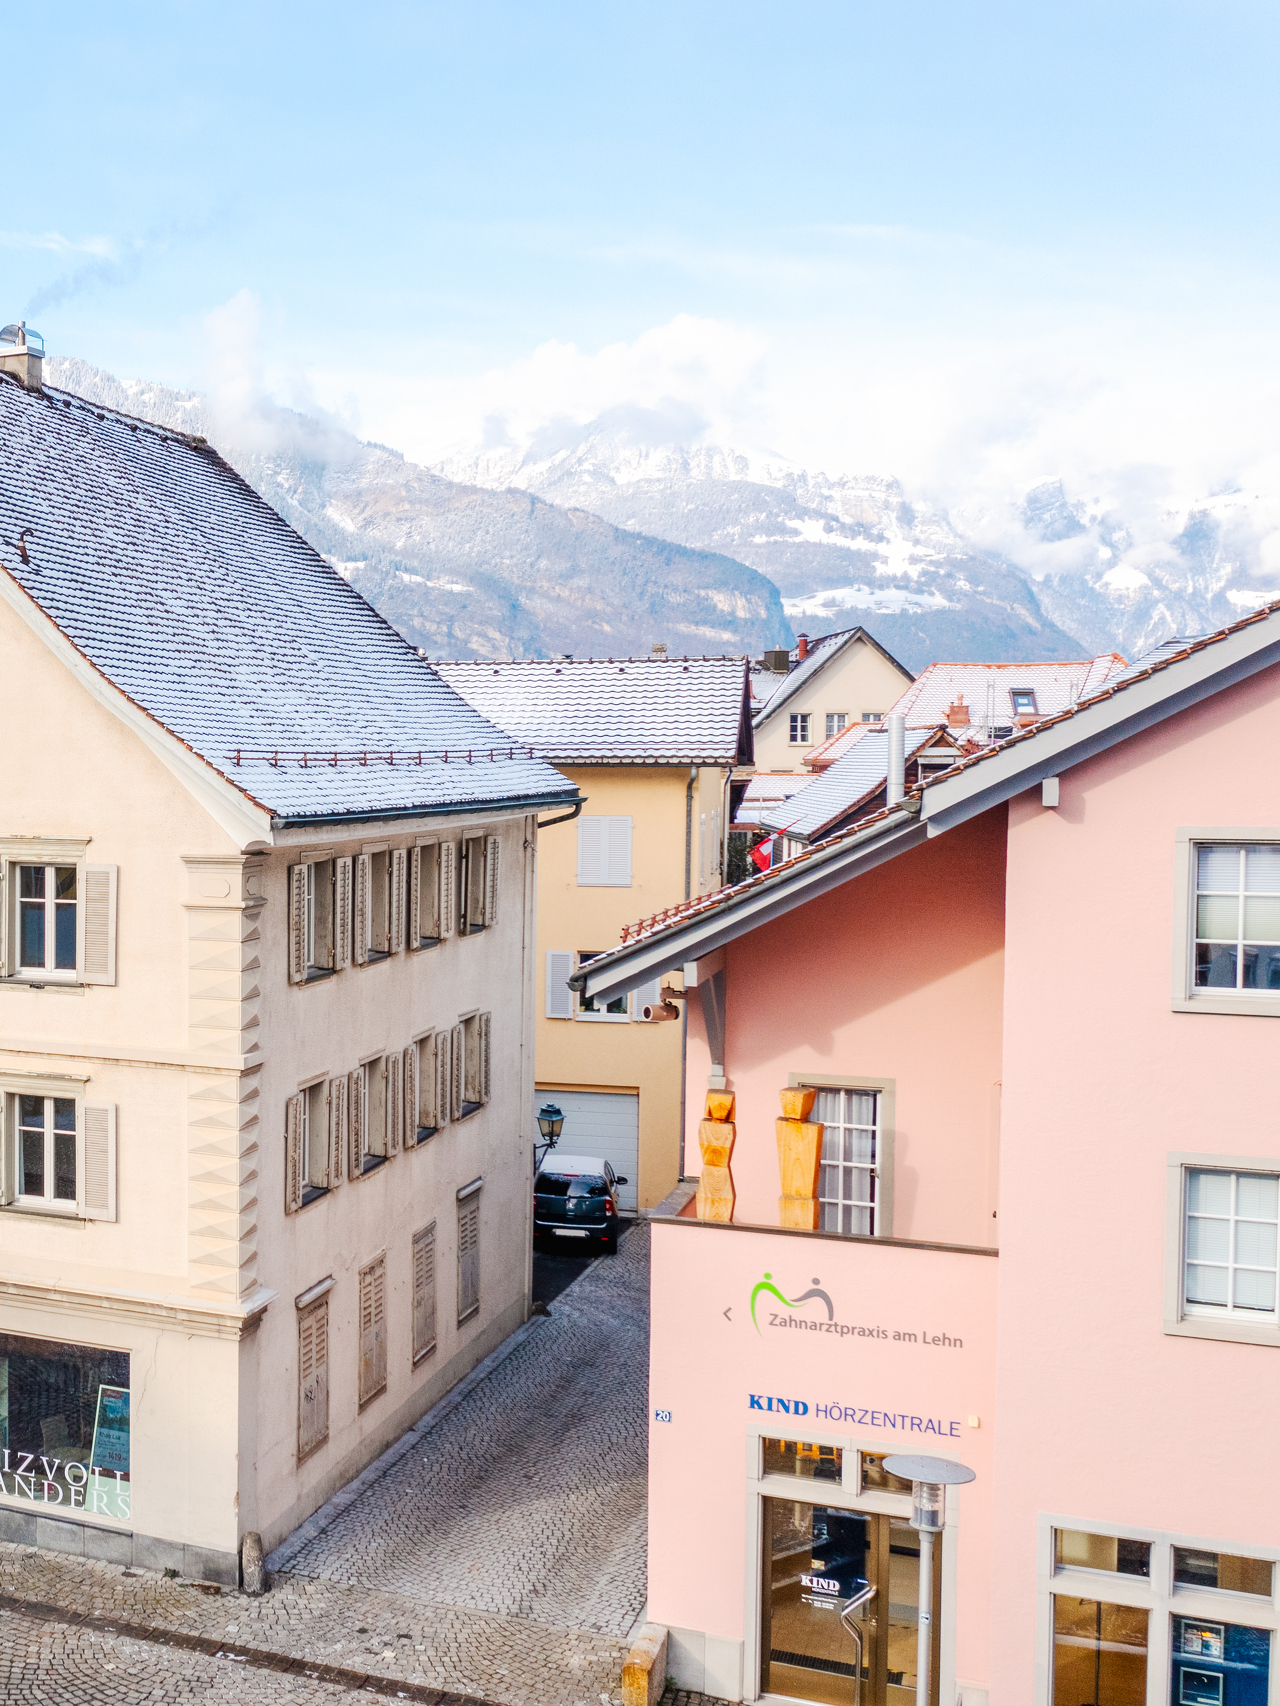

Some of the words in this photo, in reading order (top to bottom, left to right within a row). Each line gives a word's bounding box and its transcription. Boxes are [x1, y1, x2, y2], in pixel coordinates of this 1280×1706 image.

[768, 1313, 889, 1339] Zahnarztpraxis
[893, 1329, 918, 1343] am
[922, 1331, 964, 1348] Lehn
[656, 1410, 670, 1422] 20
[748, 1394, 809, 1416] KIND
[815, 1401, 961, 1438] HÖRZENTRALE
[800, 1574, 840, 1591] KIND
